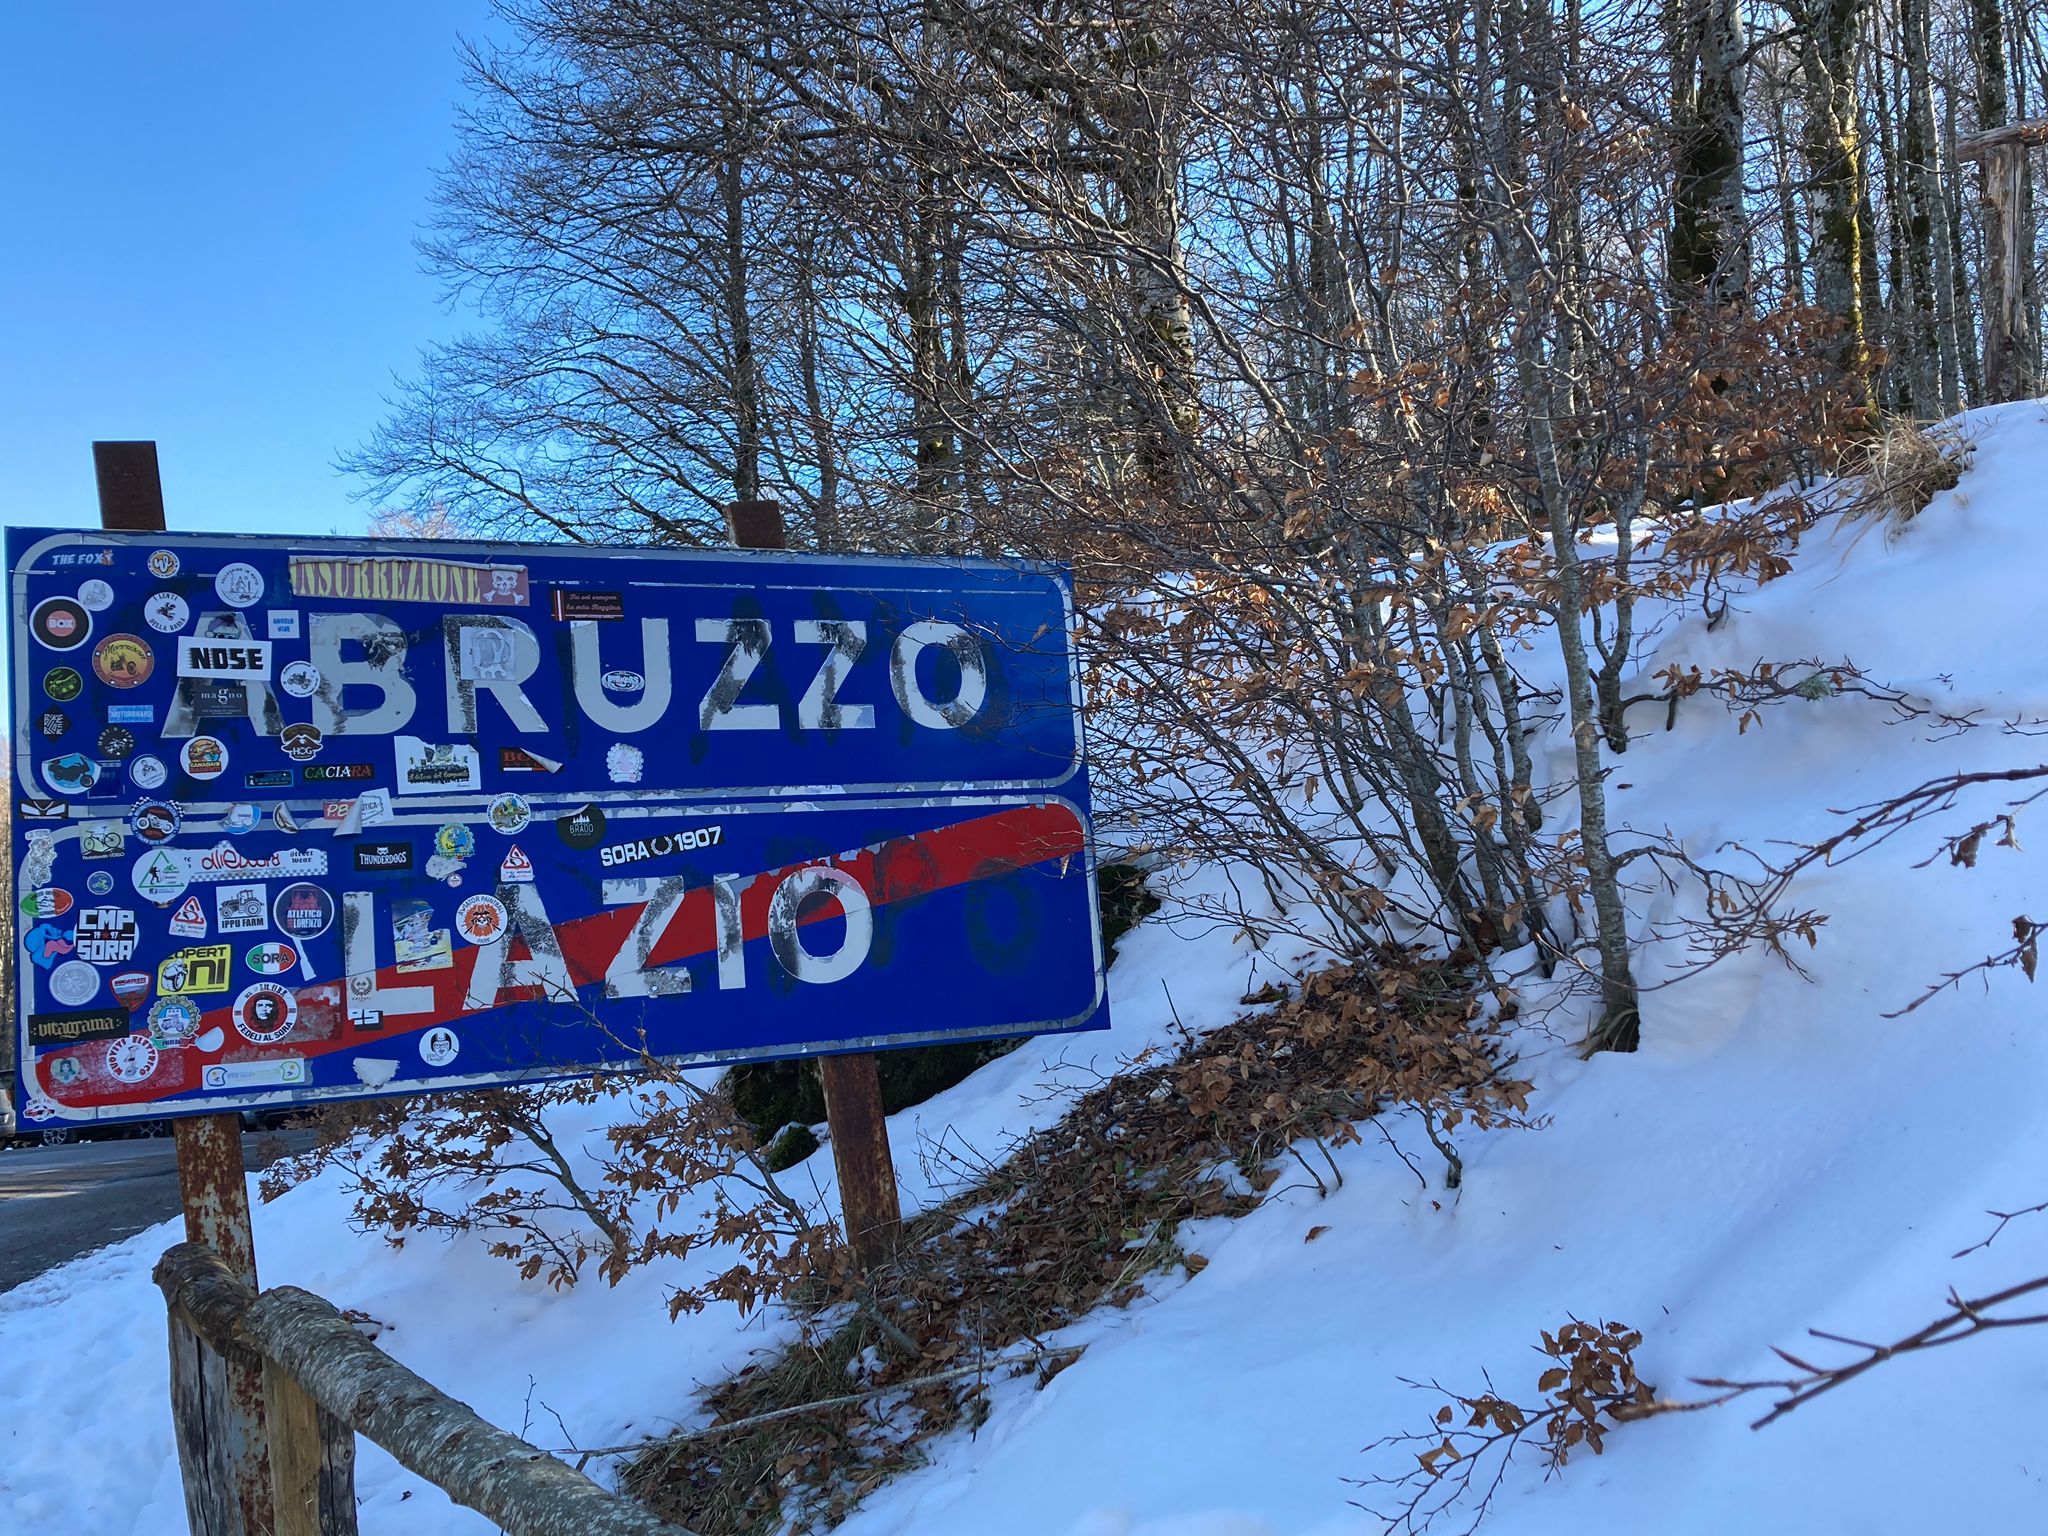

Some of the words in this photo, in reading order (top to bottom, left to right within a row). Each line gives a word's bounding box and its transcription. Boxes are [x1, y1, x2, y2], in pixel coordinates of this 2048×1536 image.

[52, 554, 77, 566] THE
[290, 559, 481, 603] INSURREZIONE
[272, 617, 294, 625] ANGELO
[161, 611, 988, 739] ABRUZZO
[200, 688, 244, 705] magno
[292, 746, 313, 755] HOG
[304, 766, 372, 779] CACIARA
[569, 823, 595, 835] BRADO
[600, 842, 650, 867] SORA
[672, 825, 723, 852] 1907
[359, 851, 407, 865] THUNDERDOGS
[78, 908, 135, 930] CMP
[287, 909, 322, 919] ATLETICO
[221, 919, 240, 929] IPPU
[241, 918, 265, 927] FARM
[293, 918, 322, 929] LORENZO
[76, 939, 134, 961] SORA
[342, 865, 875, 1022] LAZIO
[169, 946, 227, 960] OPERT
[251, 953, 291, 965] SORA
[237, 1022, 263, 1042] FEDELI
[263, 1032, 274, 1042] AL
[273, 1021, 294, 1039] SORA
